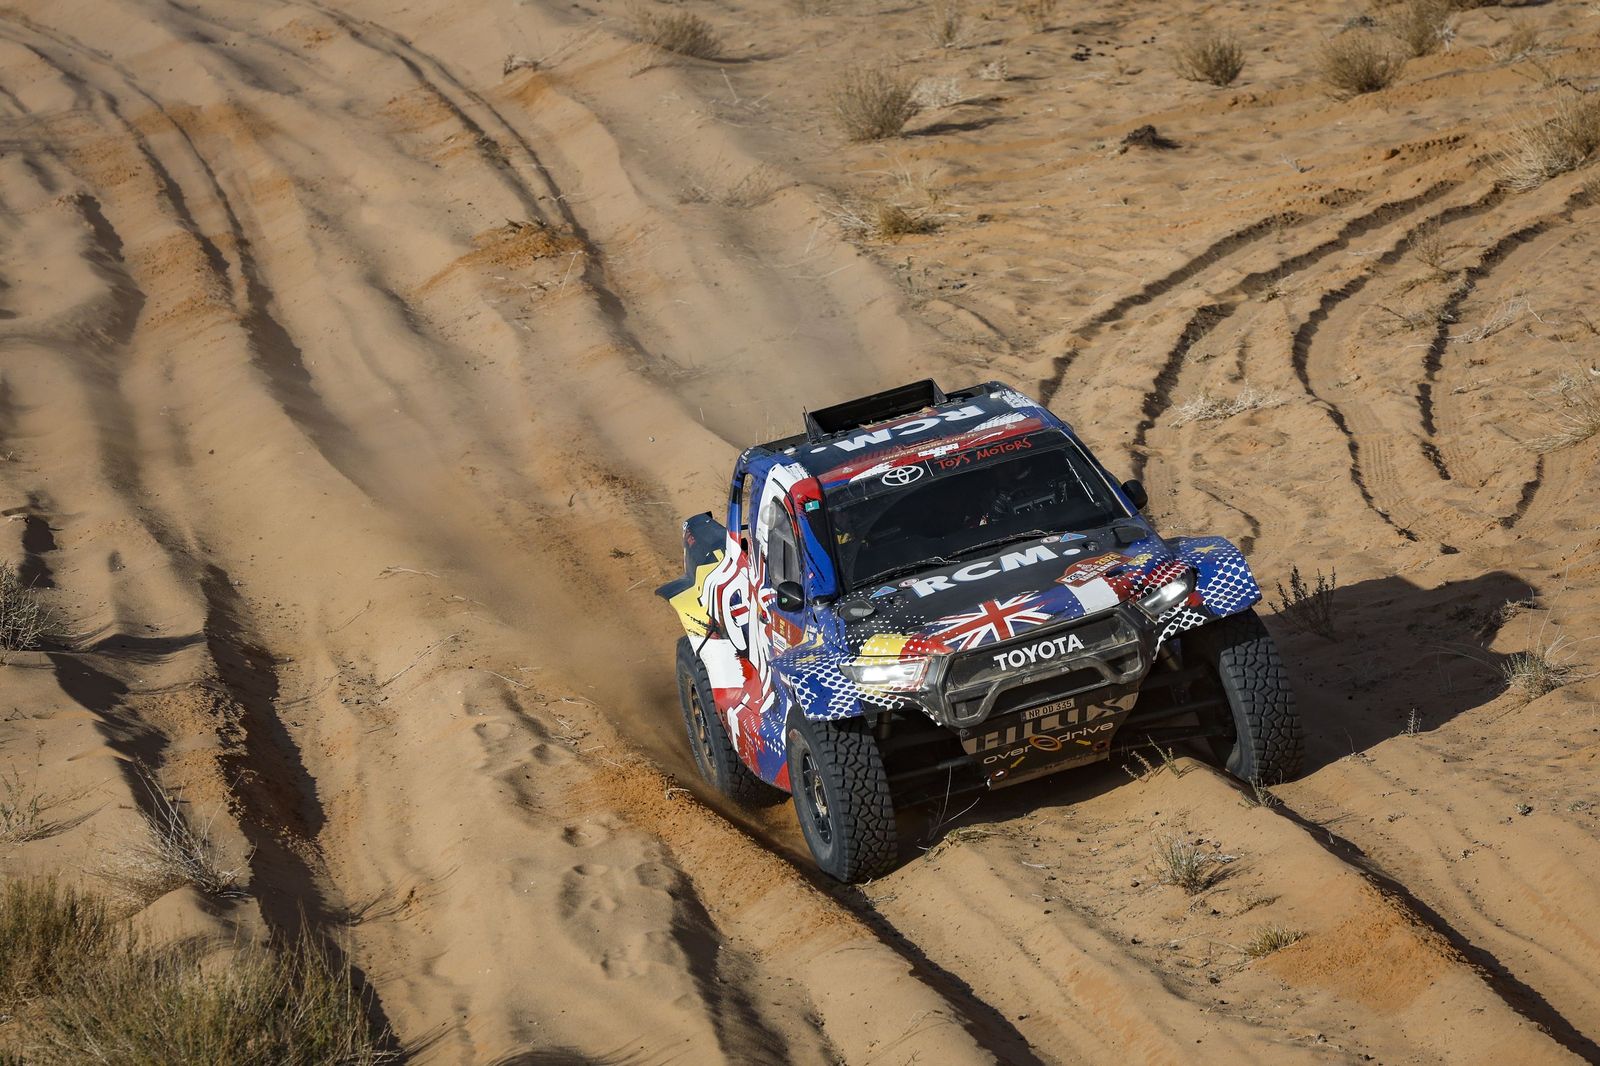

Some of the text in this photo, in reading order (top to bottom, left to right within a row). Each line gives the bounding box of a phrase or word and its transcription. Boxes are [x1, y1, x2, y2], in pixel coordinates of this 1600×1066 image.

[935, 437, 1033, 470] TOYS MOTORS
[993, 633, 1085, 671] TOYOTA
[1055, 700, 1073, 712] 335
